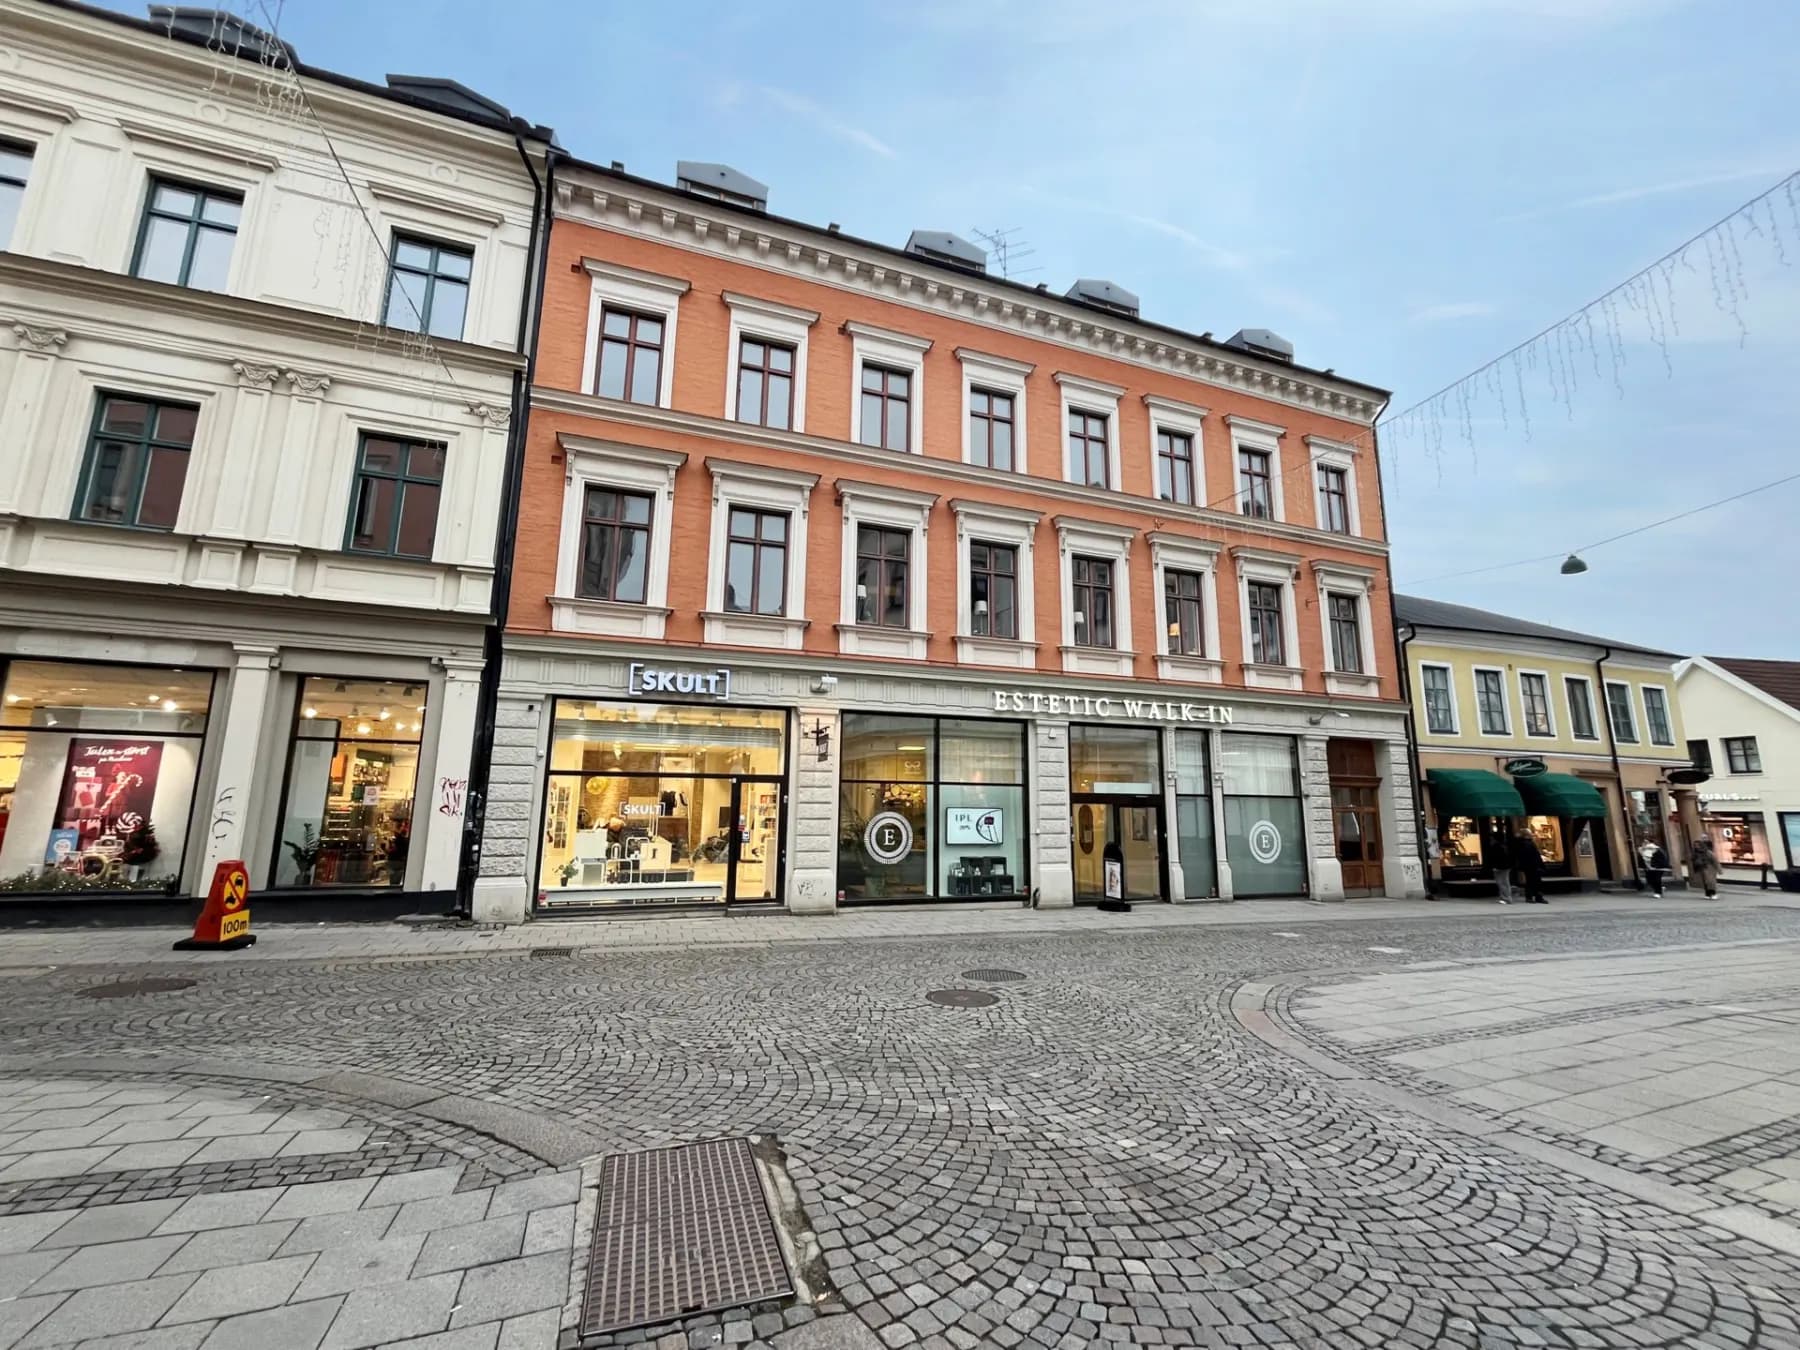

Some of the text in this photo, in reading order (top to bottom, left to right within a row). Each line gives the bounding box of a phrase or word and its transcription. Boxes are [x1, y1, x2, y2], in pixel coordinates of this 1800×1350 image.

[994, 691, 1233, 724] ESTETIC WALK-IN
[883, 829, 896, 846] E
[1261, 834, 1271, 849] E
